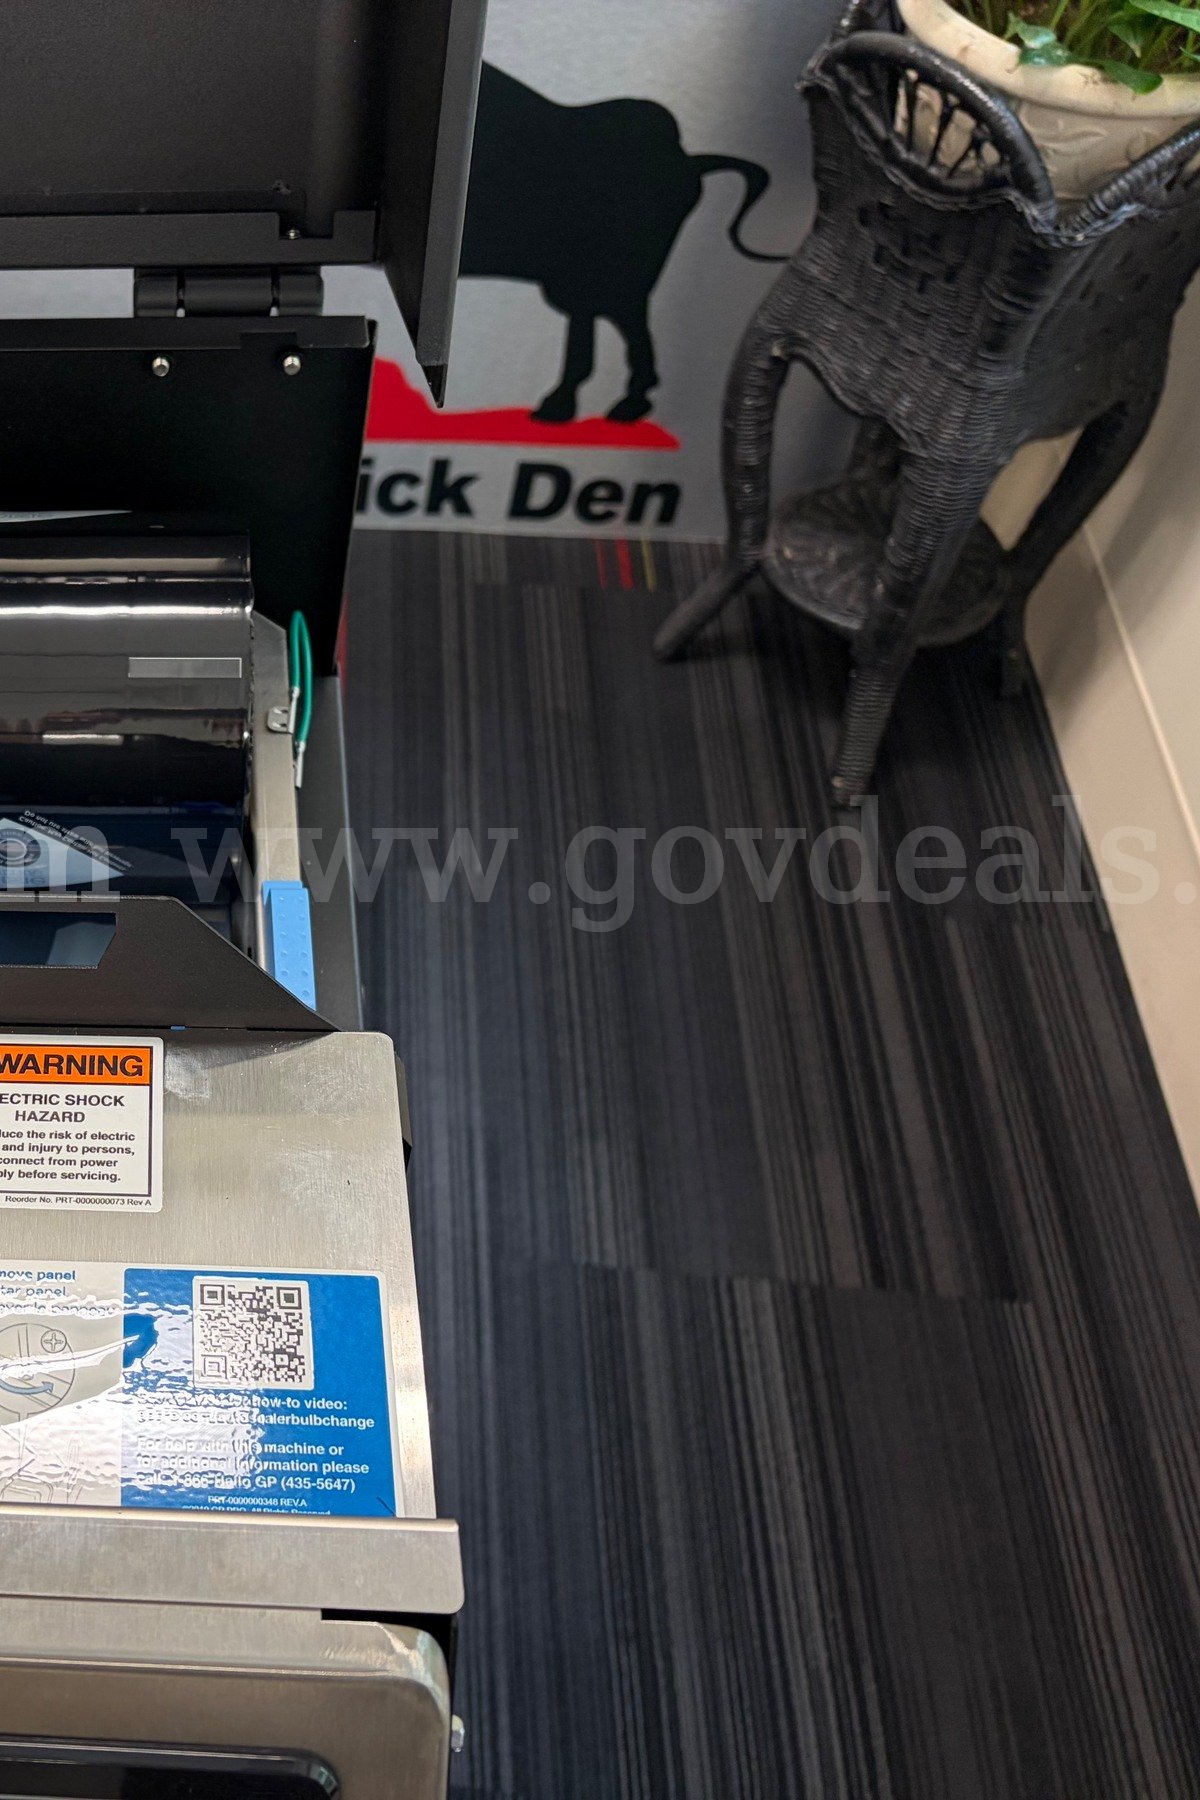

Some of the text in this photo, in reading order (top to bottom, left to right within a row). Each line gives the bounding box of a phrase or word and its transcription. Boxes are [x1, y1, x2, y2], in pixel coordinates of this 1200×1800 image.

[508, 460, 683, 526] Den
[65, 1094, 125, 1107] SHOCK
[14, 1110, 85, 1123] HAZARD
[27, 1129, 46, 1139] the
[49, 1130, 72, 1140] risk
[75, 1131, 87, 1140] of
[90, 1131, 136, 1141] electric
[1, 1142, 24, 1152] and
[28, 1143, 63, 1154] injury
[66, 1144, 79, 1153] to
[81, 1145, 135, 1156] persons,
[48, 1156, 77, 1166] from
[80, 1158, 118, 1168] power
[18, 1169, 57, 1179] before
[60, 1171, 121, 1182] servicing.
[5, 1195, 37, 1203] Reorder
[36, 1270, 76, 1281] panel
[26, 1286, 66, 1297] panel
[304, 1399, 348, 1410] video:
[264, 1442, 325, 1455] machine
[329, 1446, 344, 1456] or
[322, 1460, 370, 1475] please
[255, 1476, 277, 1488] GP
[281, 1477, 355, 1493] (435-5647)
